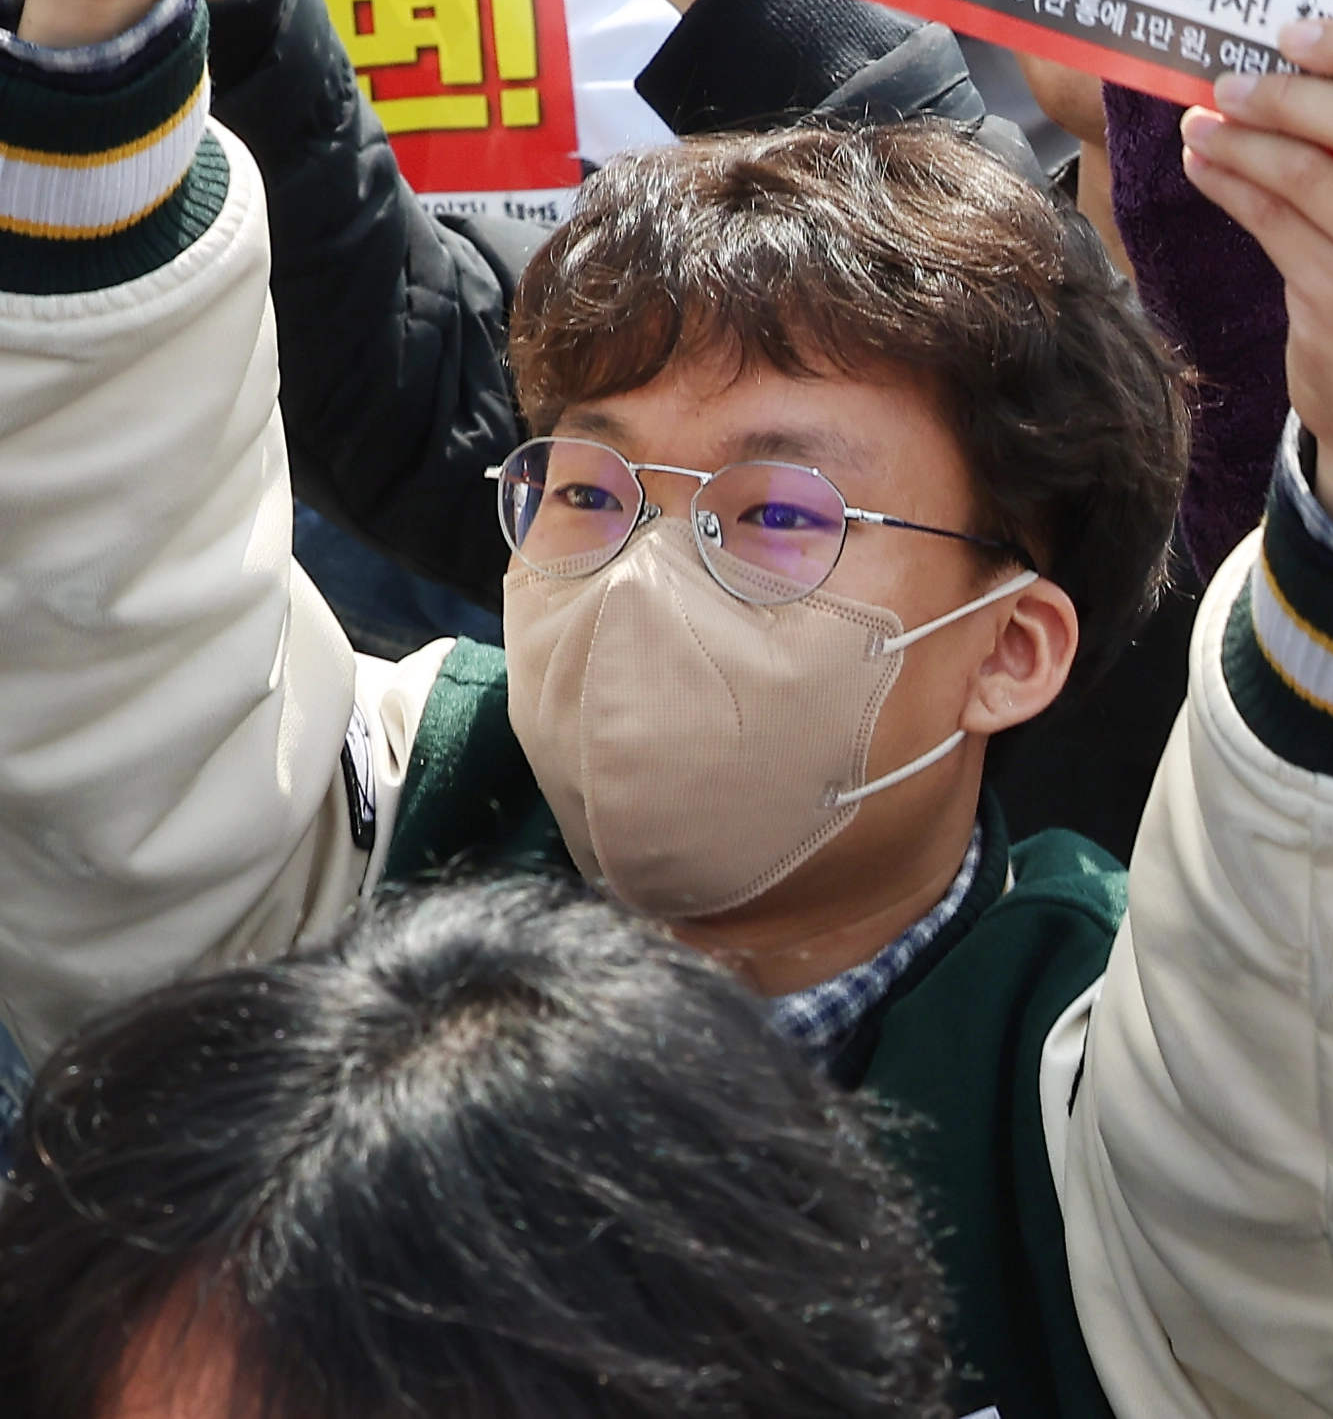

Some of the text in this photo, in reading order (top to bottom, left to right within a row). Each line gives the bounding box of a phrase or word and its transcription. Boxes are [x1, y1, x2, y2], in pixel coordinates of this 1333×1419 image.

[1130, 12, 1175, 52] 1만
[1179, 27, 1213, 67] 원,
[1219, 40, 1271, 75] 여러
